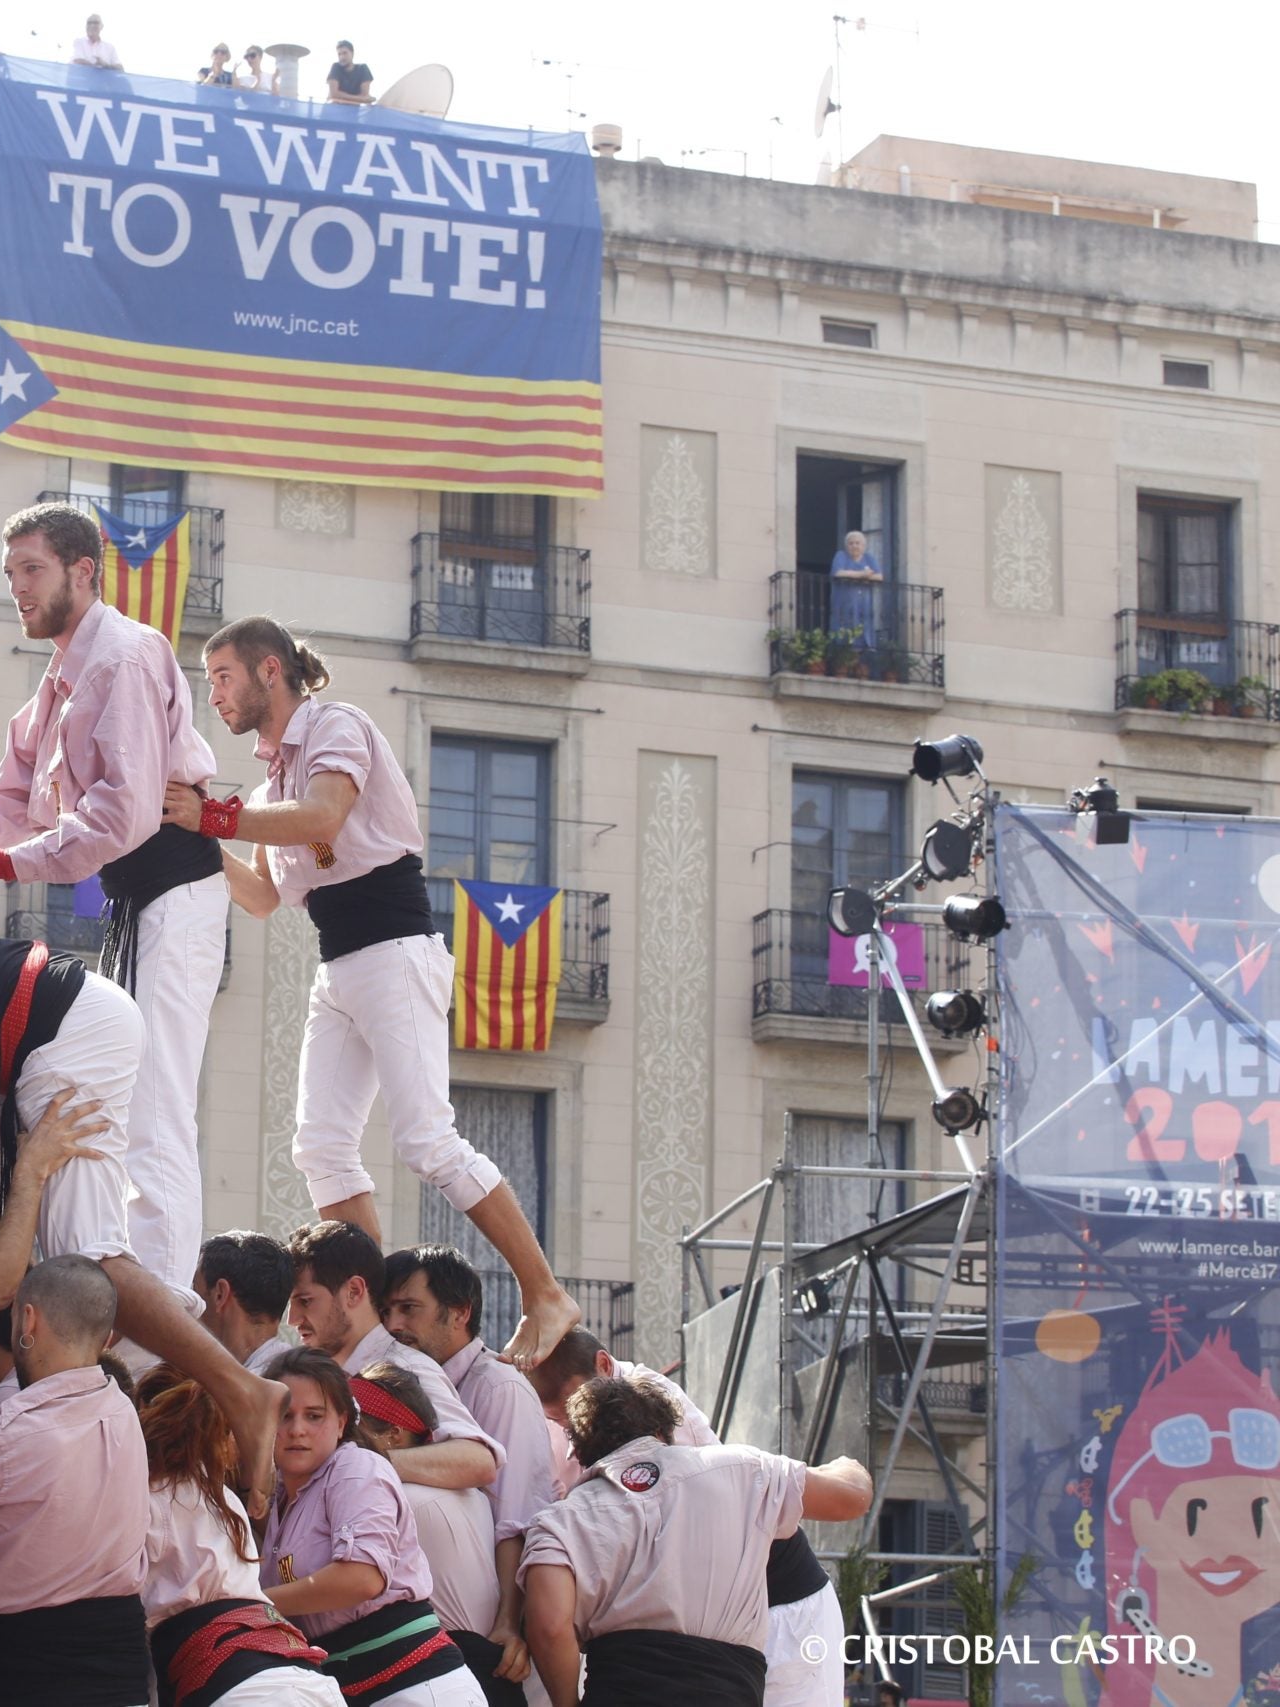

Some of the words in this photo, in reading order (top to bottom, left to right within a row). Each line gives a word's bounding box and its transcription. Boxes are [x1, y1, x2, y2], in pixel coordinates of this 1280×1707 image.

[36, 90, 220, 178] WE
[233, 117, 550, 218] WANT
[49, 171, 192, 268] TO
[220, 193, 546, 310] VOTE!
[233, 310, 360, 338] www.jnc.cat
[1221, 1189, 1280, 1221] SETE
[1138, 1238, 1280, 1257] www.lamerce.bar
[1197, 1261, 1278, 1279] #Mercè17
